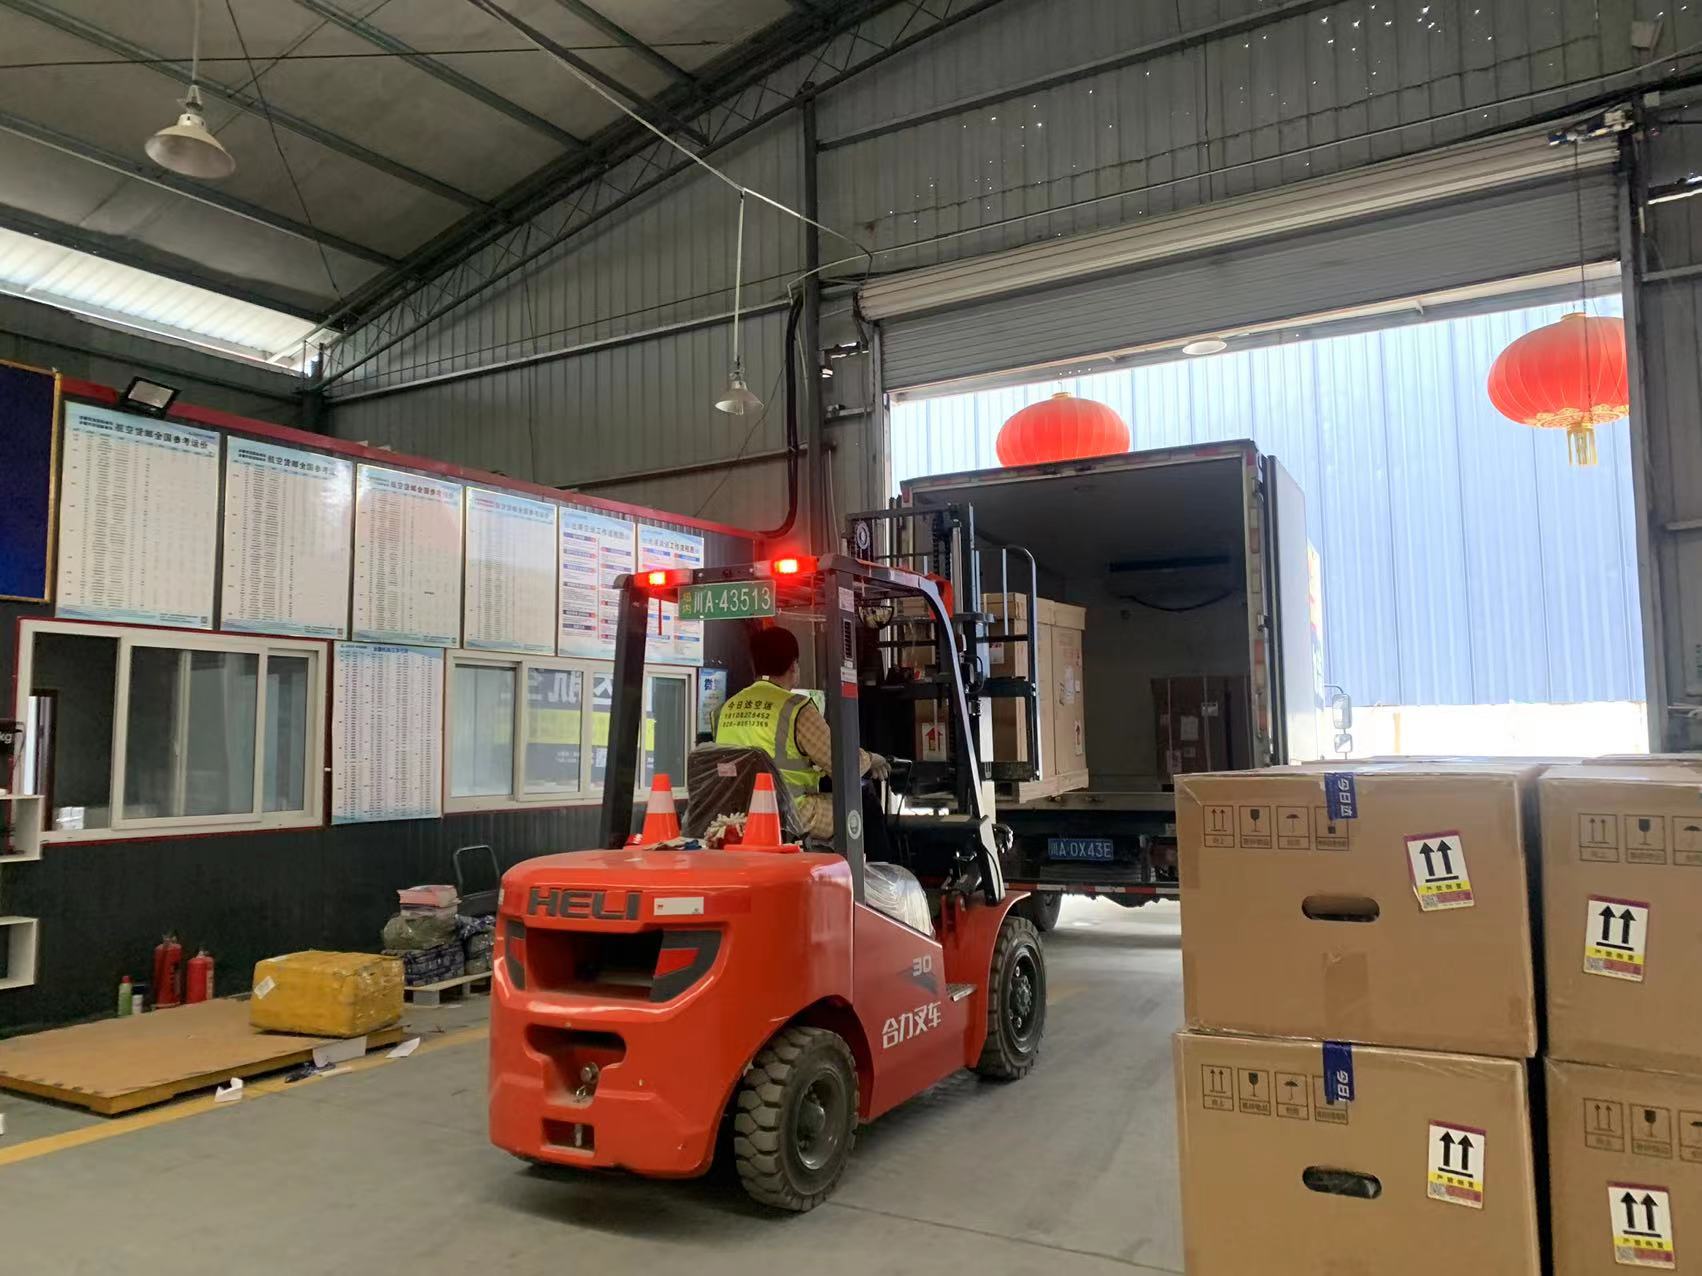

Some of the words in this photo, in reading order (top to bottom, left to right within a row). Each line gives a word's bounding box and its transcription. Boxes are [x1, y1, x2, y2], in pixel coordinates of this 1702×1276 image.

[528, 887, 642, 920] HELI
[912, 955, 932, 976] 30
[882, 1001, 941, 1049] 合力叉车
[1336, 1070, 1350, 1102] 今日
